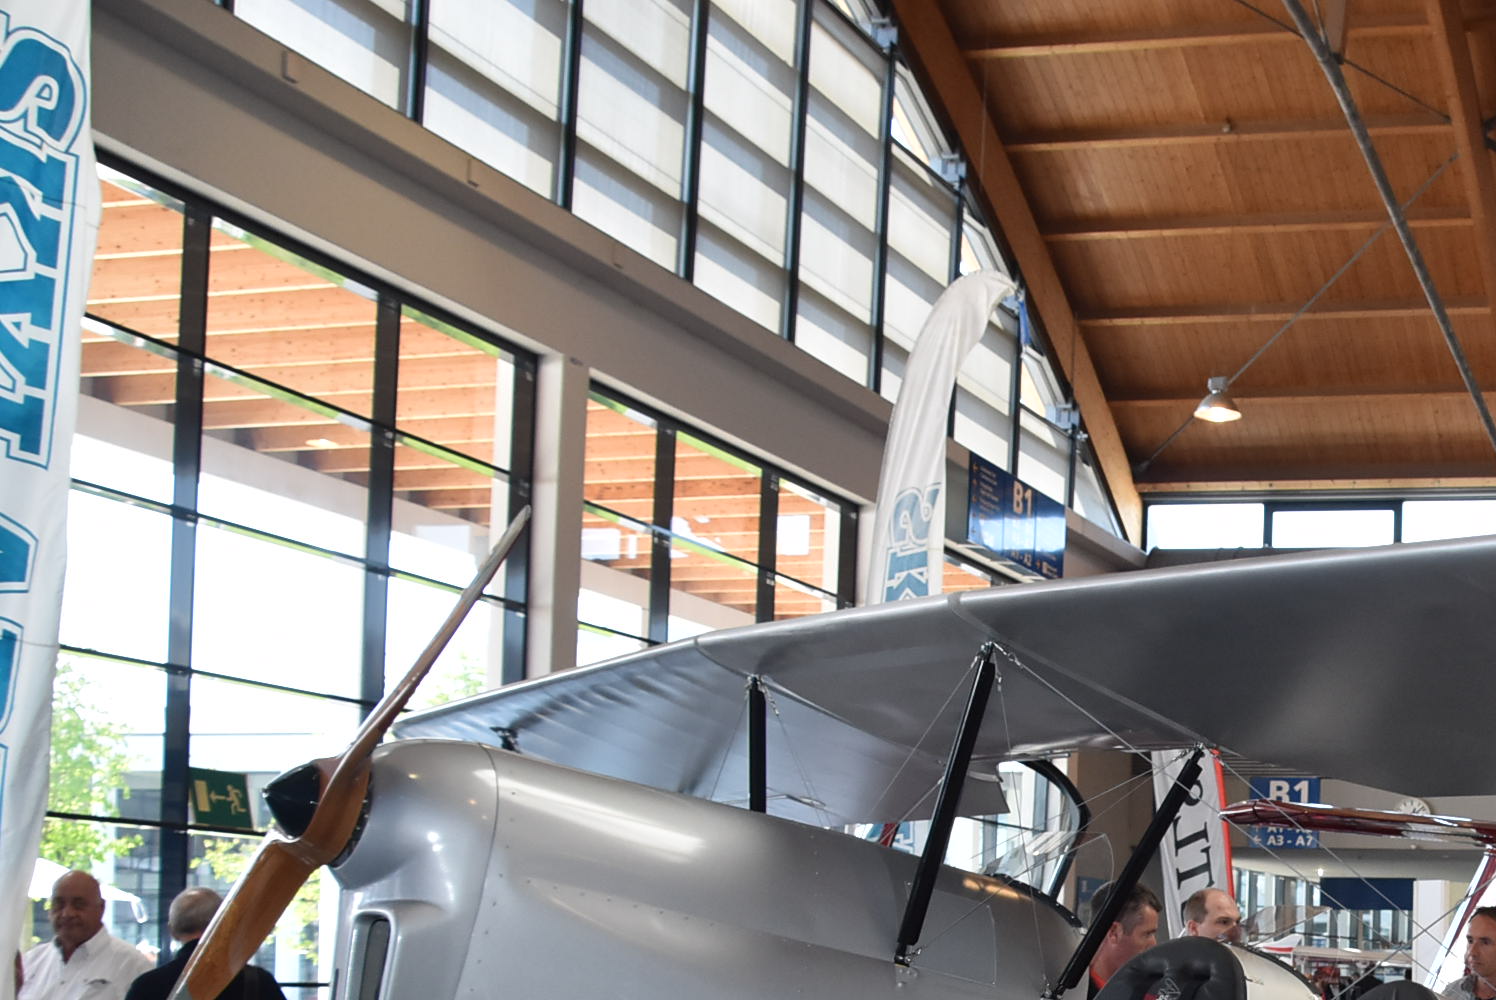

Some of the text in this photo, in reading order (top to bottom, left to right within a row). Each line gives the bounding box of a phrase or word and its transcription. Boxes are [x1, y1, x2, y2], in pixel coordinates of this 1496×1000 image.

[1013, 480, 1032, 518] B1
[1269, 780, 1309, 804] B1
[1266, 835, 1284, 846] A3
[1295, 835, 1313, 846] A7
